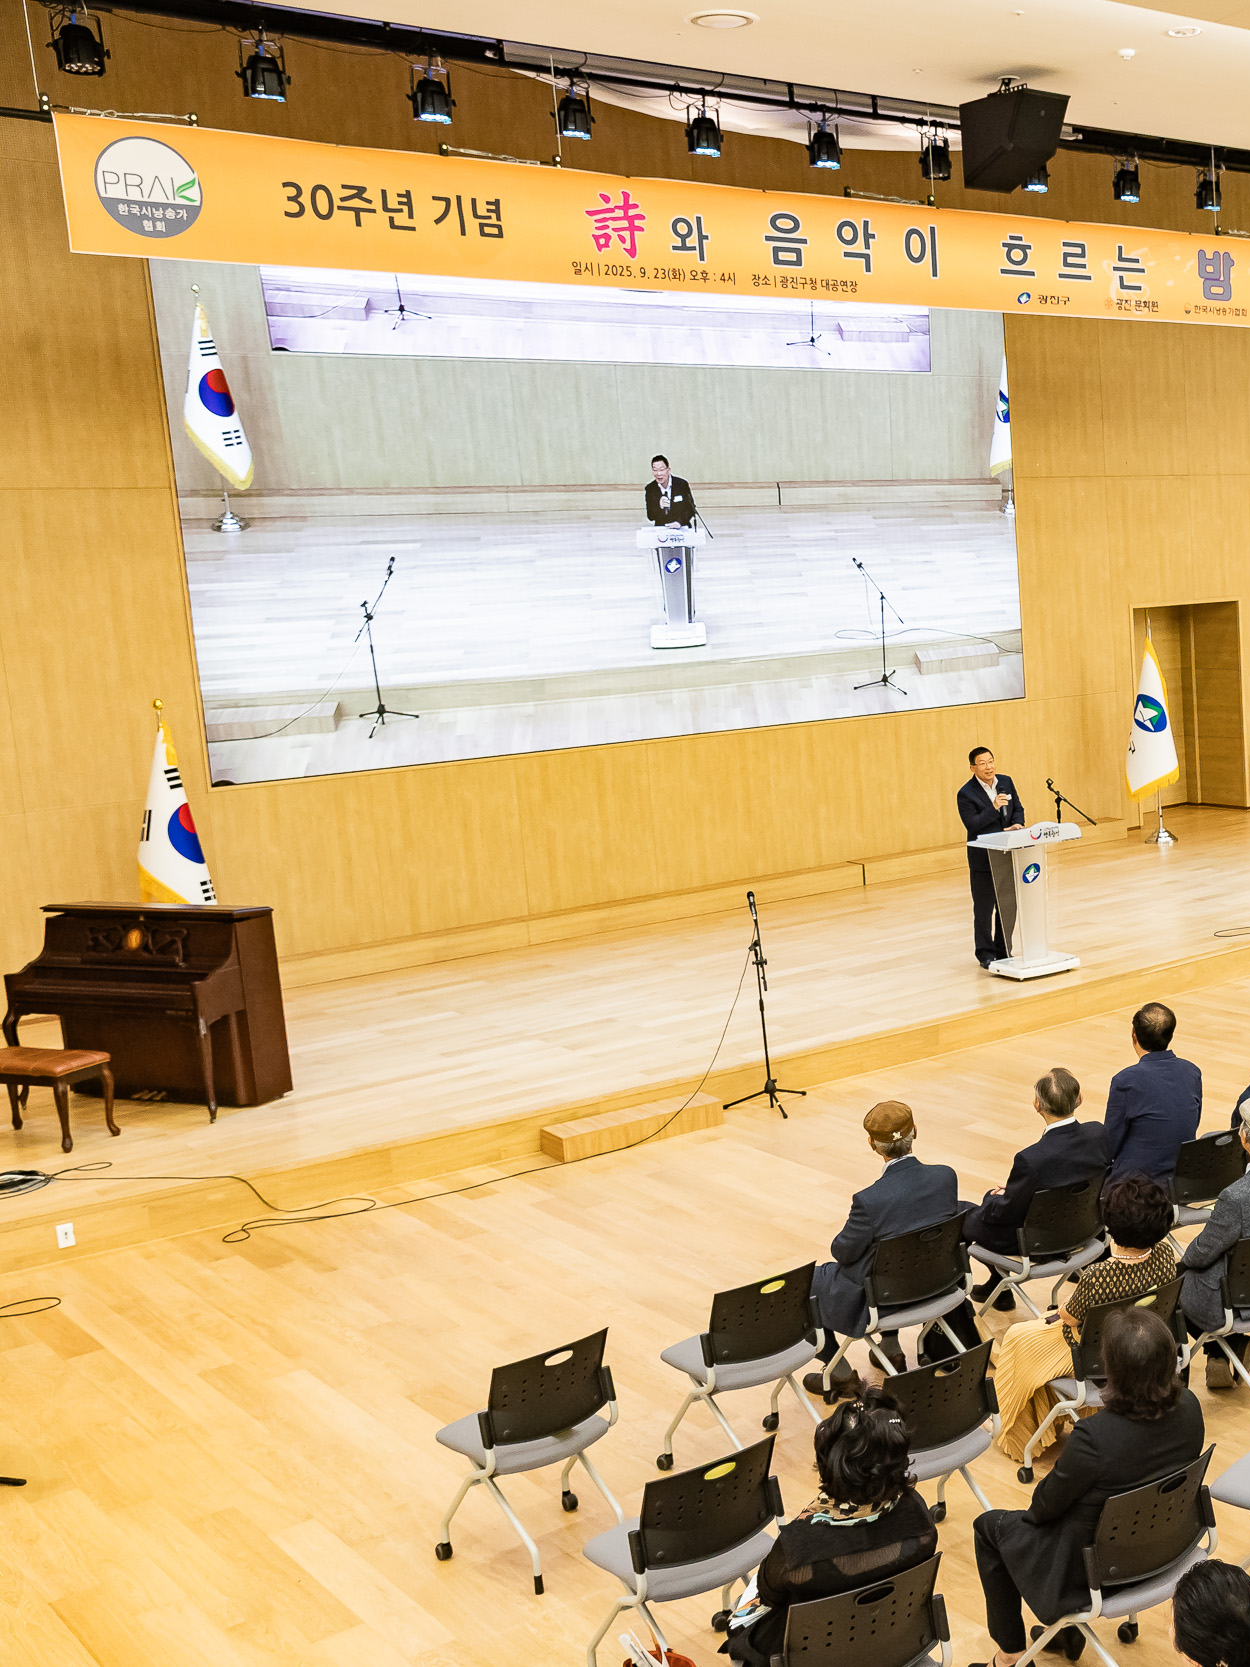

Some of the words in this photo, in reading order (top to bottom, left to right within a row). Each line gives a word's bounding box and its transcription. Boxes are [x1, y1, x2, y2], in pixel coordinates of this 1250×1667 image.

[102, 170, 197, 202] PRAK
[117, 203, 188, 220] 한국시낭송가
[281, 181, 417, 232] 30주년
[431, 194, 504, 239] 기념
[142, 219, 166, 232] 협회
[764, 212, 939, 278] 음악이
[999, 234, 1147, 292] 흐르는
[1197, 249, 1235, 302] 밤
[572, 261, 594, 276] 일시
[604, 264, 636, 279] 2025.
[639, 266, 650, 280] 9.
[653, 268, 686, 282] 23(화)
[689, 269, 710, 284] 오후
[719, 272, 736, 286] 4시
[751, 273, 771, 287] 장소
[779, 275, 818, 291] 광진구청
[820, 279, 858, 294] 대공연장
[1037, 294, 1070, 305] 광진구
[1116, 298, 1132, 311] 광진
